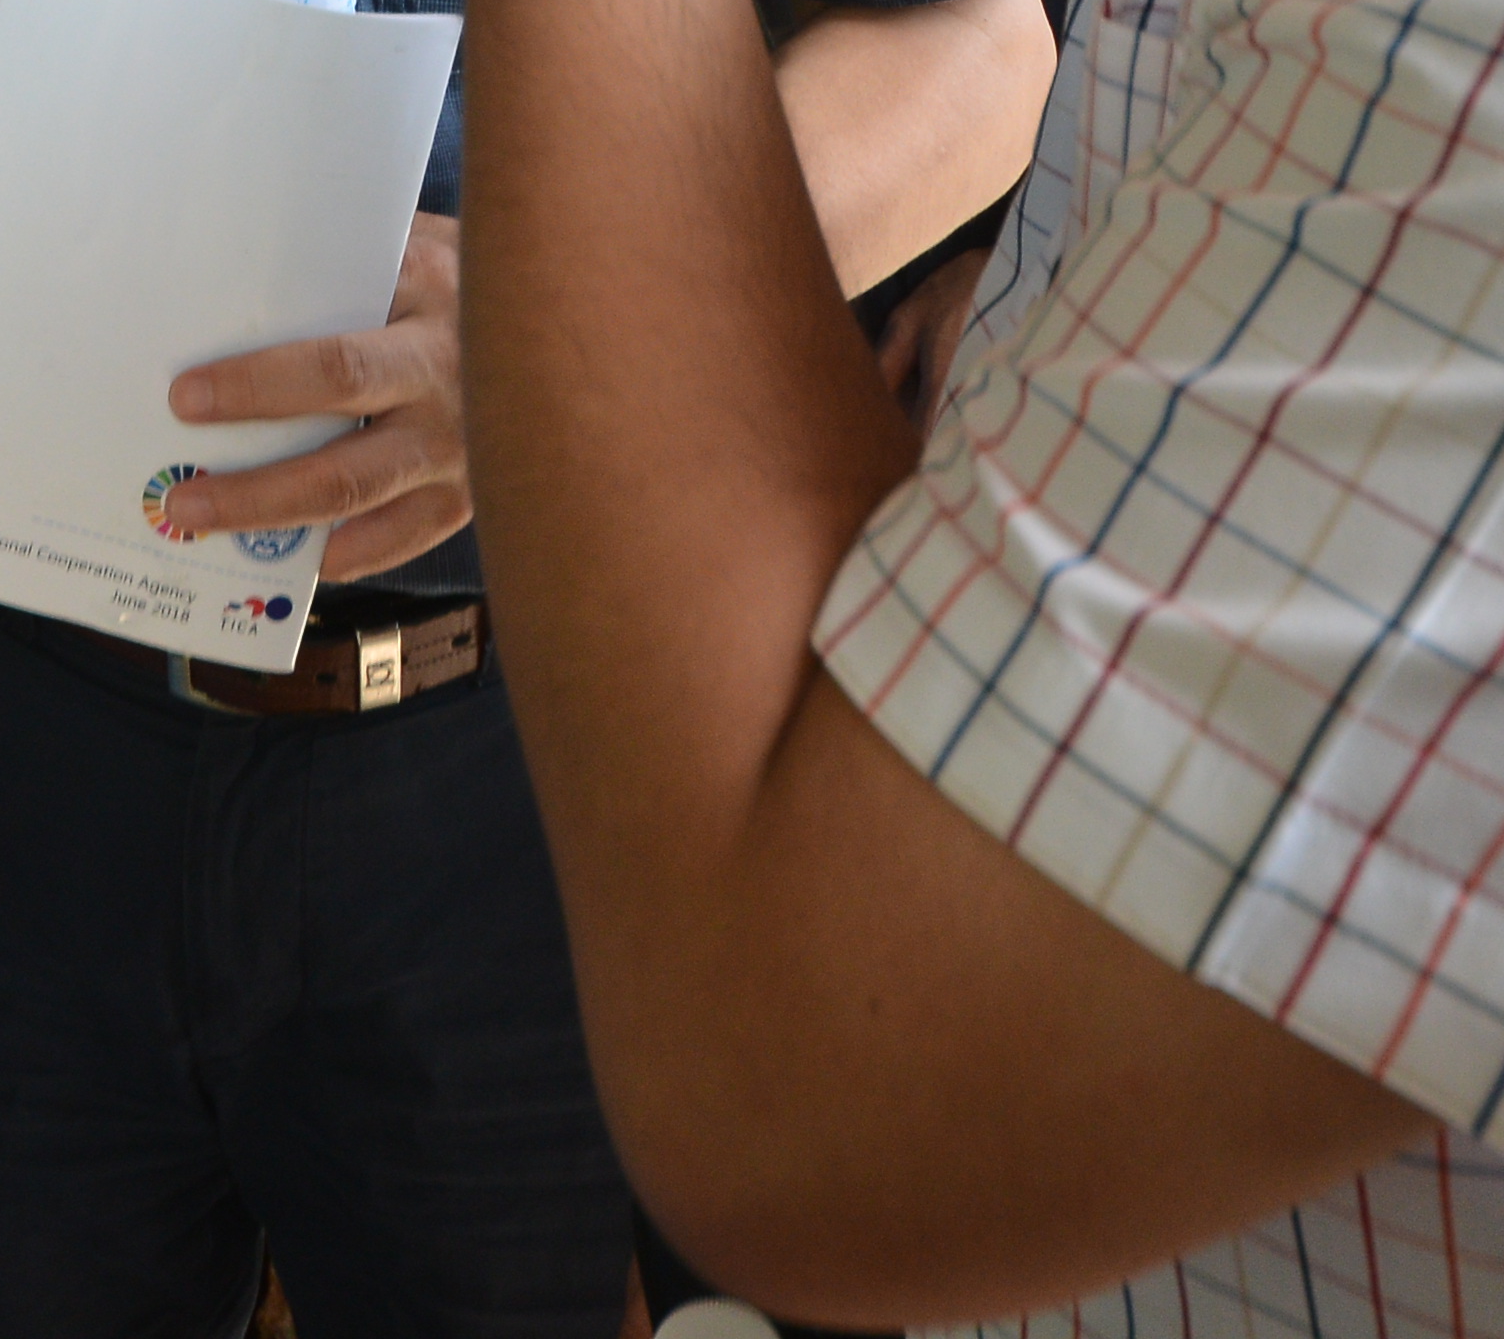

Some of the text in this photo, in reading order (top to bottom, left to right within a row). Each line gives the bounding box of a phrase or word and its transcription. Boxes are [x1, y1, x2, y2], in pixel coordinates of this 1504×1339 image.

[37, 545, 133, 587] Cooperation
[138, 573, 198, 606] Agency
[112, 588, 191, 624] June 2018
[220, 616, 259, 637] TICA
